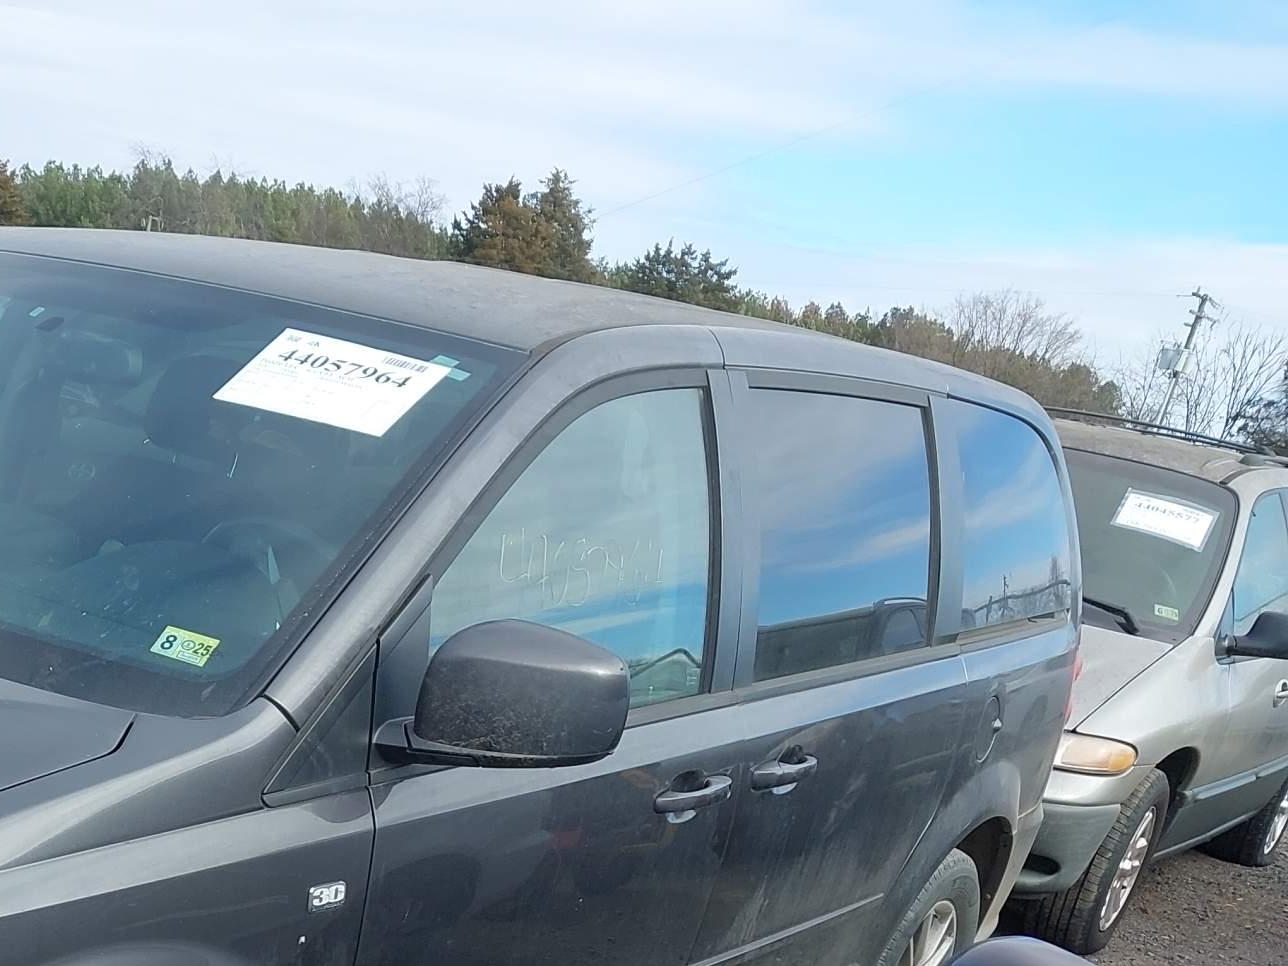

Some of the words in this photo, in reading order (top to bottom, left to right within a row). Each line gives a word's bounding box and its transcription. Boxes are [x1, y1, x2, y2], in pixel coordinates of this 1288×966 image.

[278, 349, 412, 388] 44057964
[192, 642, 214, 657] 25
[312, 884, 345, 906] 30
